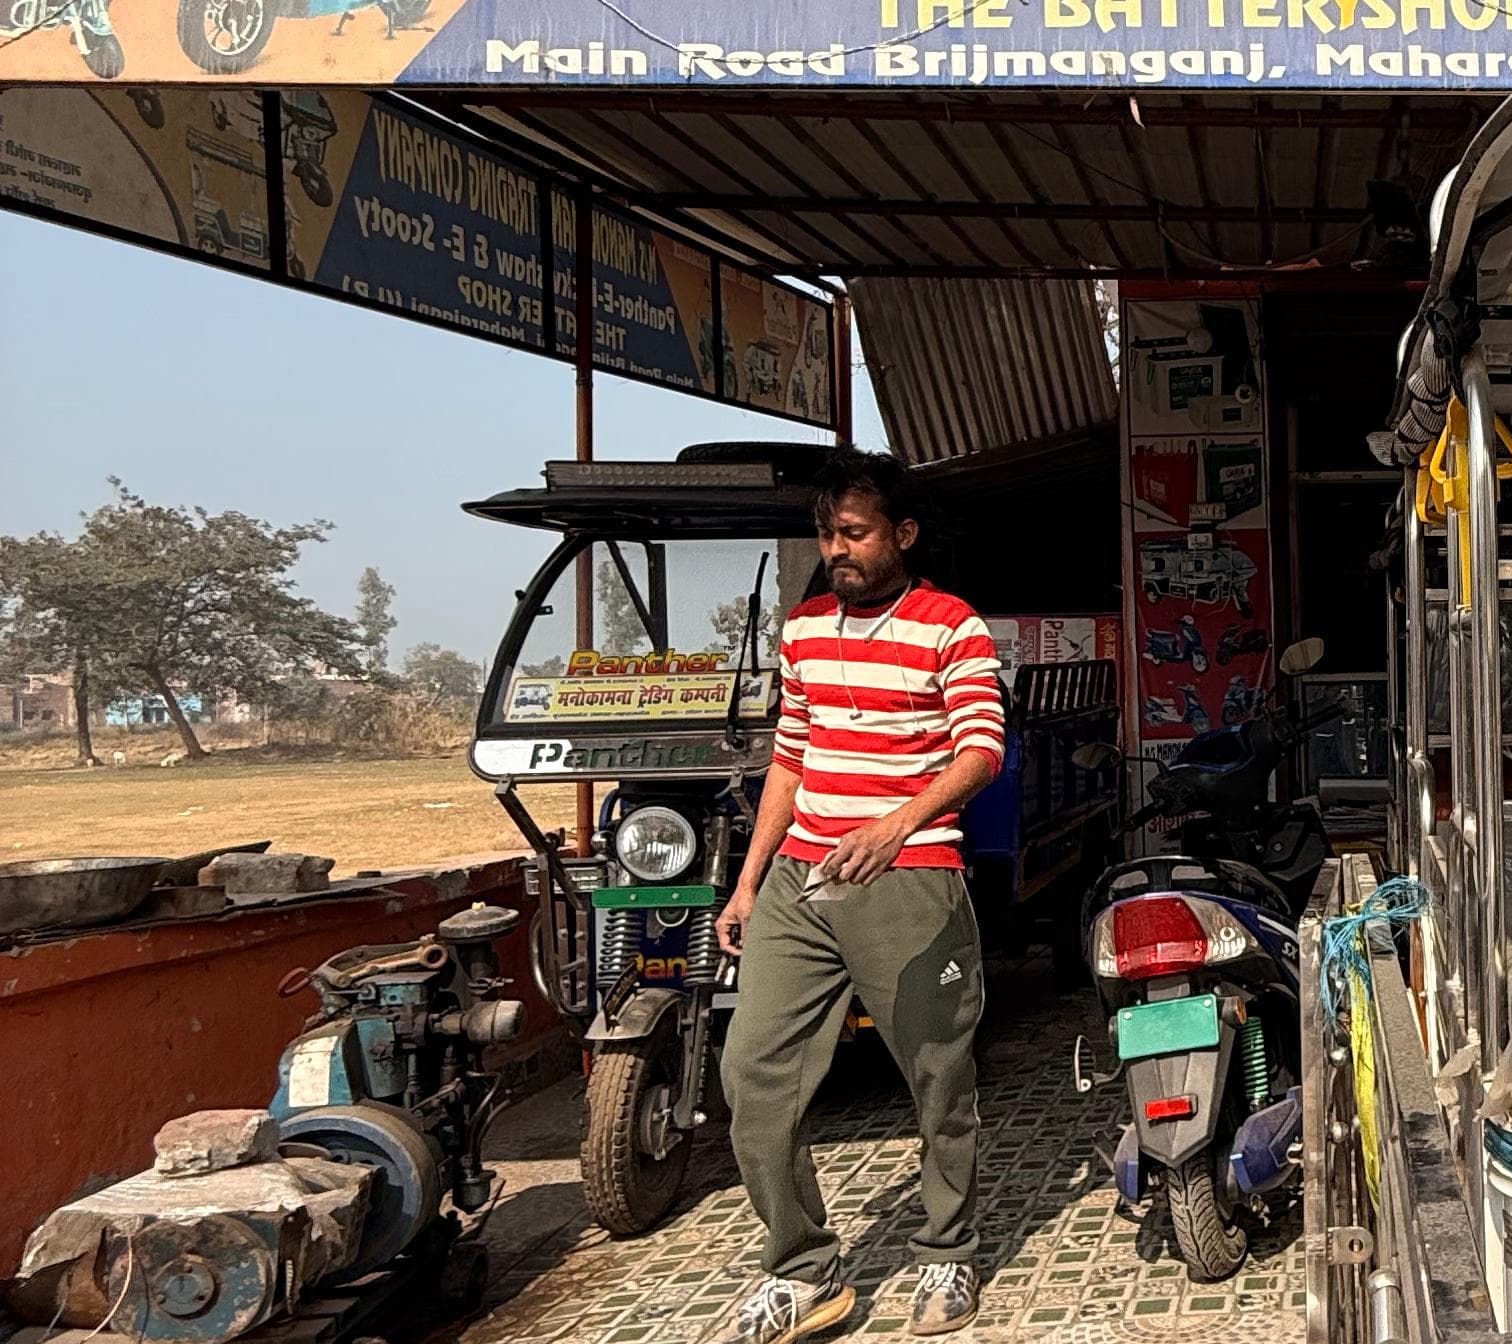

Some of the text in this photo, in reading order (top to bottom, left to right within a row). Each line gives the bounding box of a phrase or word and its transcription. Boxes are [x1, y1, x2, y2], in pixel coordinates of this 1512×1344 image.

[486, 40, 650, 77] Main
[680, 41, 846, 79] Road
[873, 42, 1287, 84] Brijmanganj,
[1043, 621, 1064, 663] Panth
[566, 646, 730, 676] Panther
[557, 681, 730, 709] मनोकामना ट्रेडिंग कम्पनी
[529, 738, 724, 771] Panther
